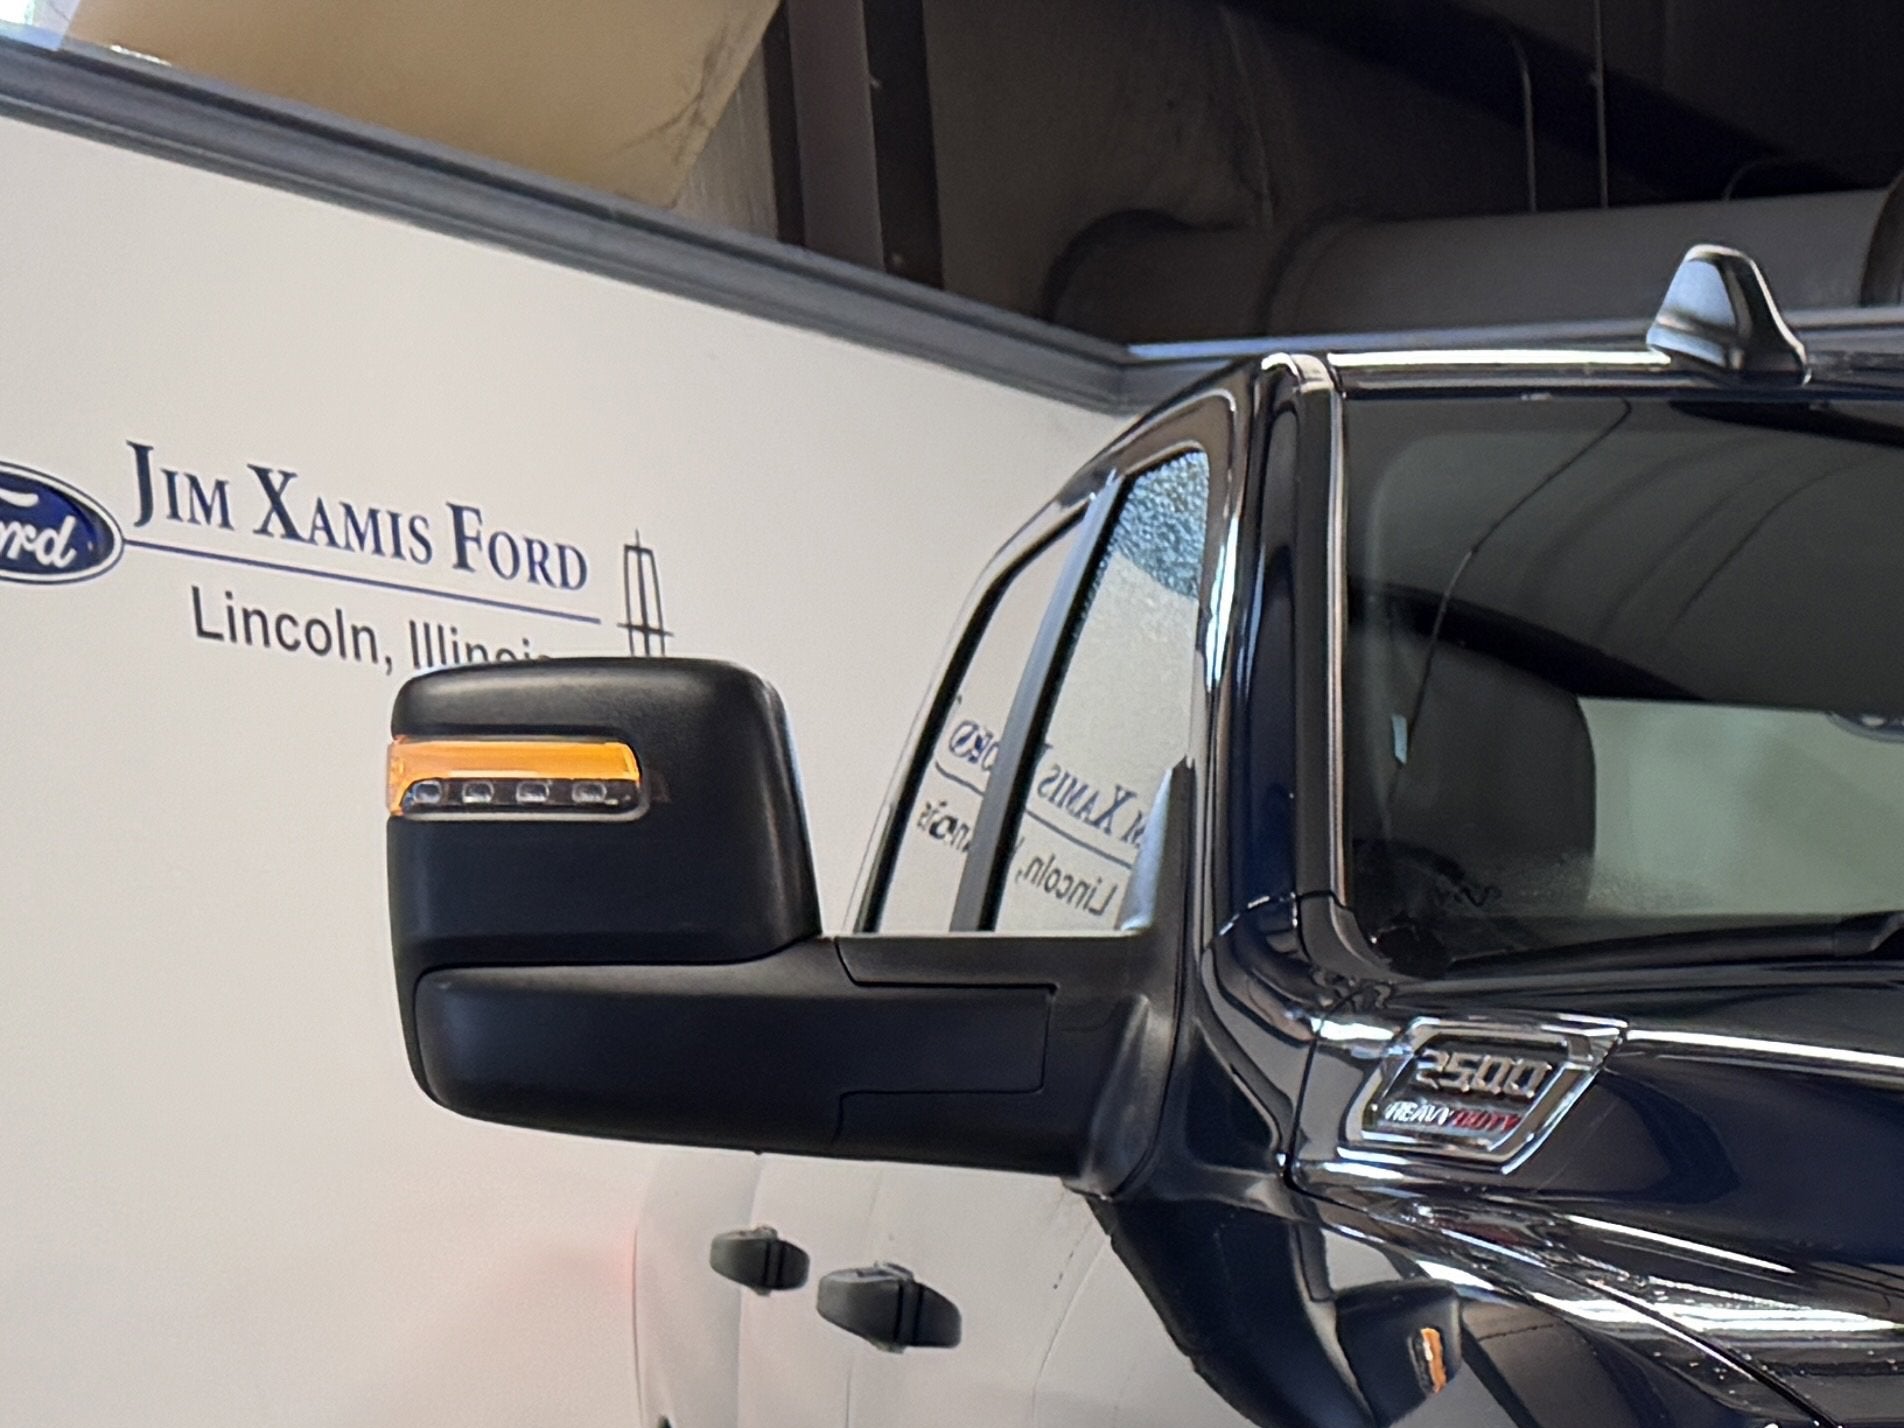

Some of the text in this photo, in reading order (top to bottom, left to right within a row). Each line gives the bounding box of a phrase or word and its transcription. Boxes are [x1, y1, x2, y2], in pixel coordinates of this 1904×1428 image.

[0, 487, 78, 569] rd
[445, 500, 588, 591] FORD
[191, 584, 552, 676] Lincoln, Illin
[1384, 1100, 1454, 1126] HEAVY
[1415, 1048, 1553, 1099] 2500
